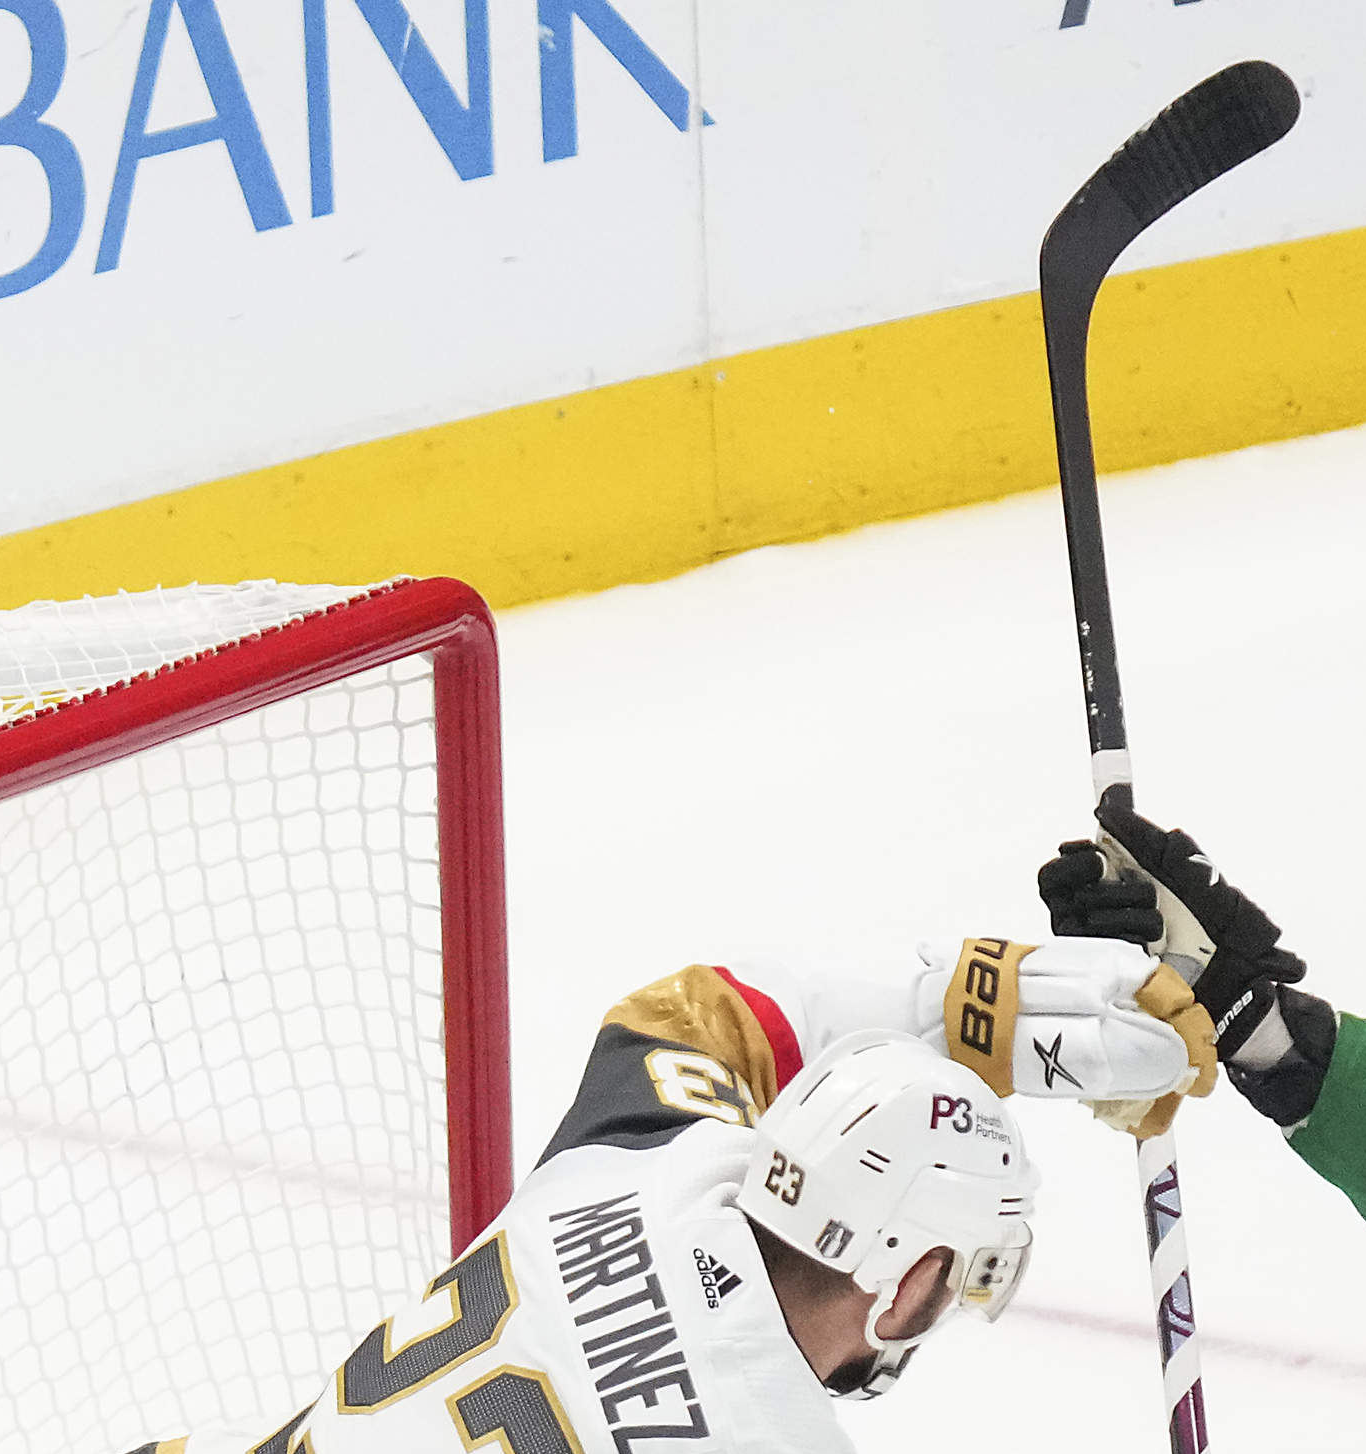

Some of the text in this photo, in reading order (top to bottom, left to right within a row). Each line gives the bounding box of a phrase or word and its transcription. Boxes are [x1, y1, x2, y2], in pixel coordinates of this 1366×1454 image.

[929, 1093, 973, 1134] P3
[763, 1149, 806, 1207] 23
[692, 1247, 720, 1310] adidas
